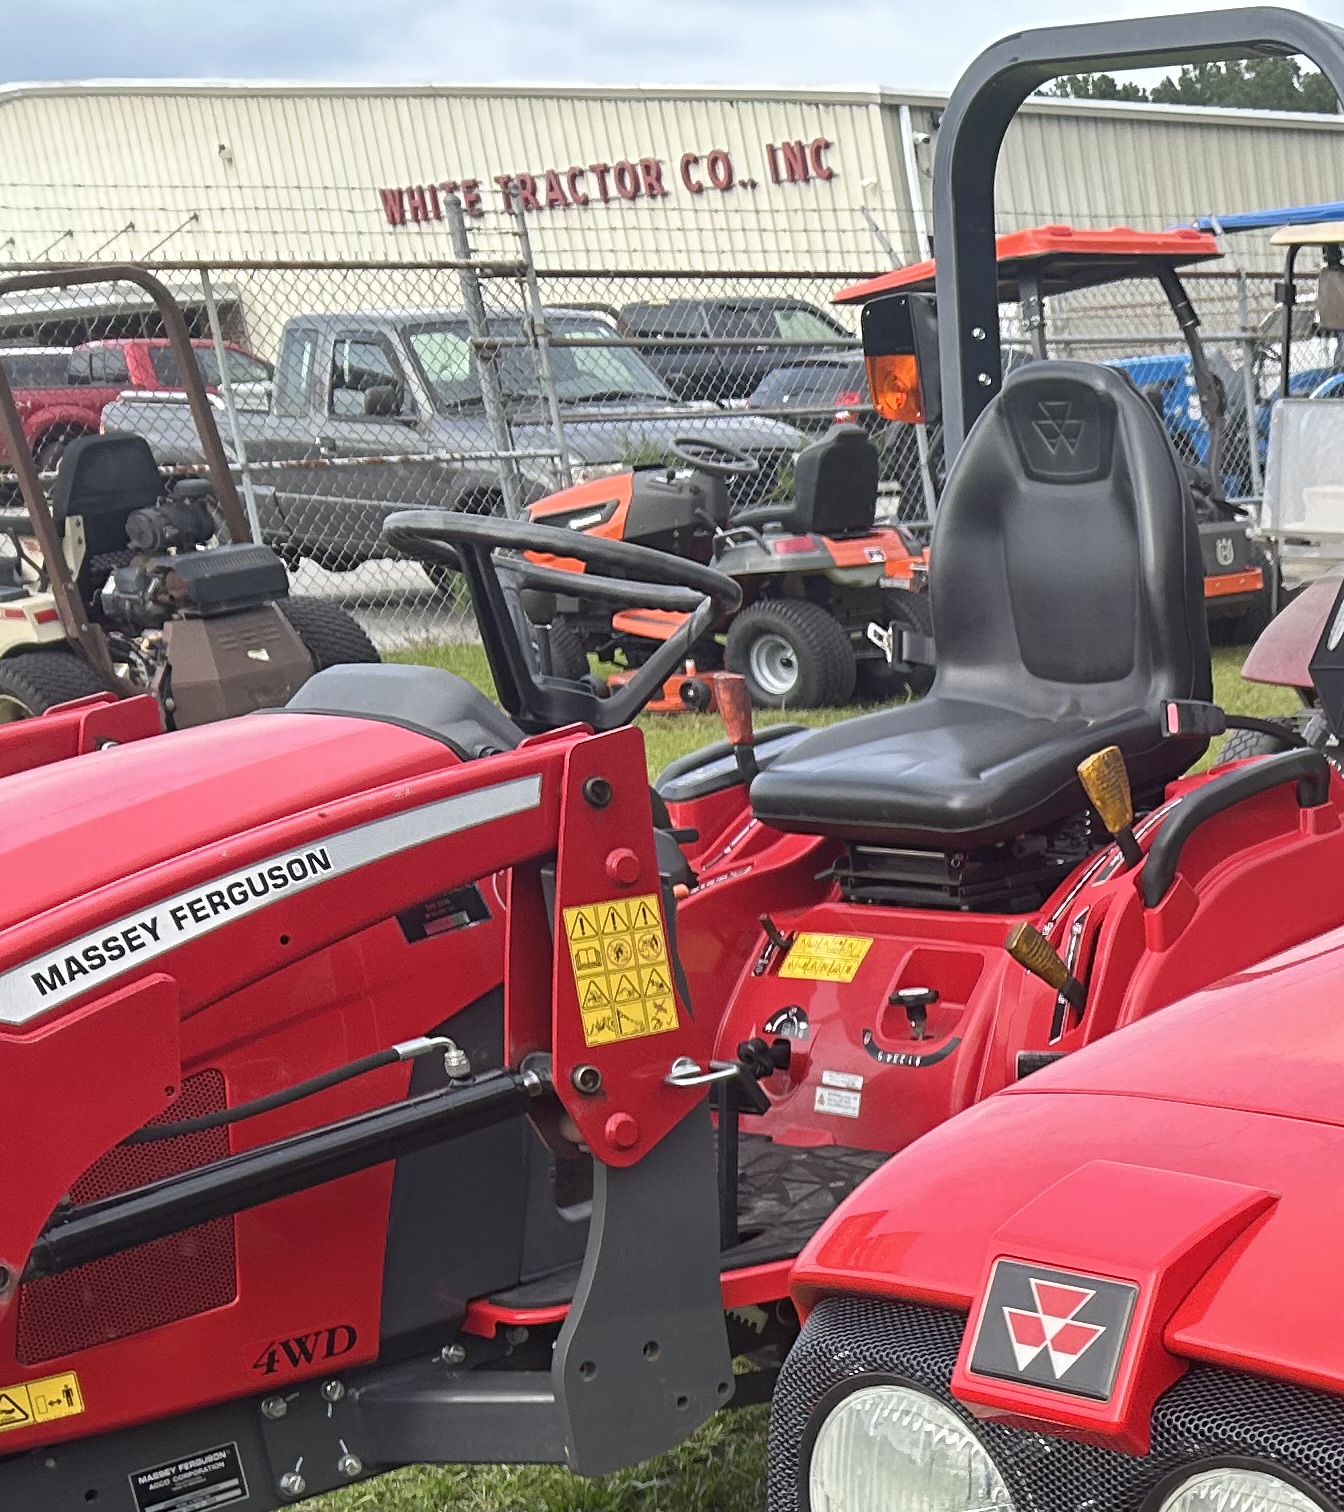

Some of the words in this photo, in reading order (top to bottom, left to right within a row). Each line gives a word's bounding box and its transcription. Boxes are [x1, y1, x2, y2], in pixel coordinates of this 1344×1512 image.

[380, 179, 482, 226] WHITE
[495, 157, 669, 214] TRACTOR
[766, 137, 834, 184] INC
[31, 917, 160, 995] MASSEY
[169, 848, 332, 930] FERGUSON
[252, 1324, 358, 1377] 4WD
